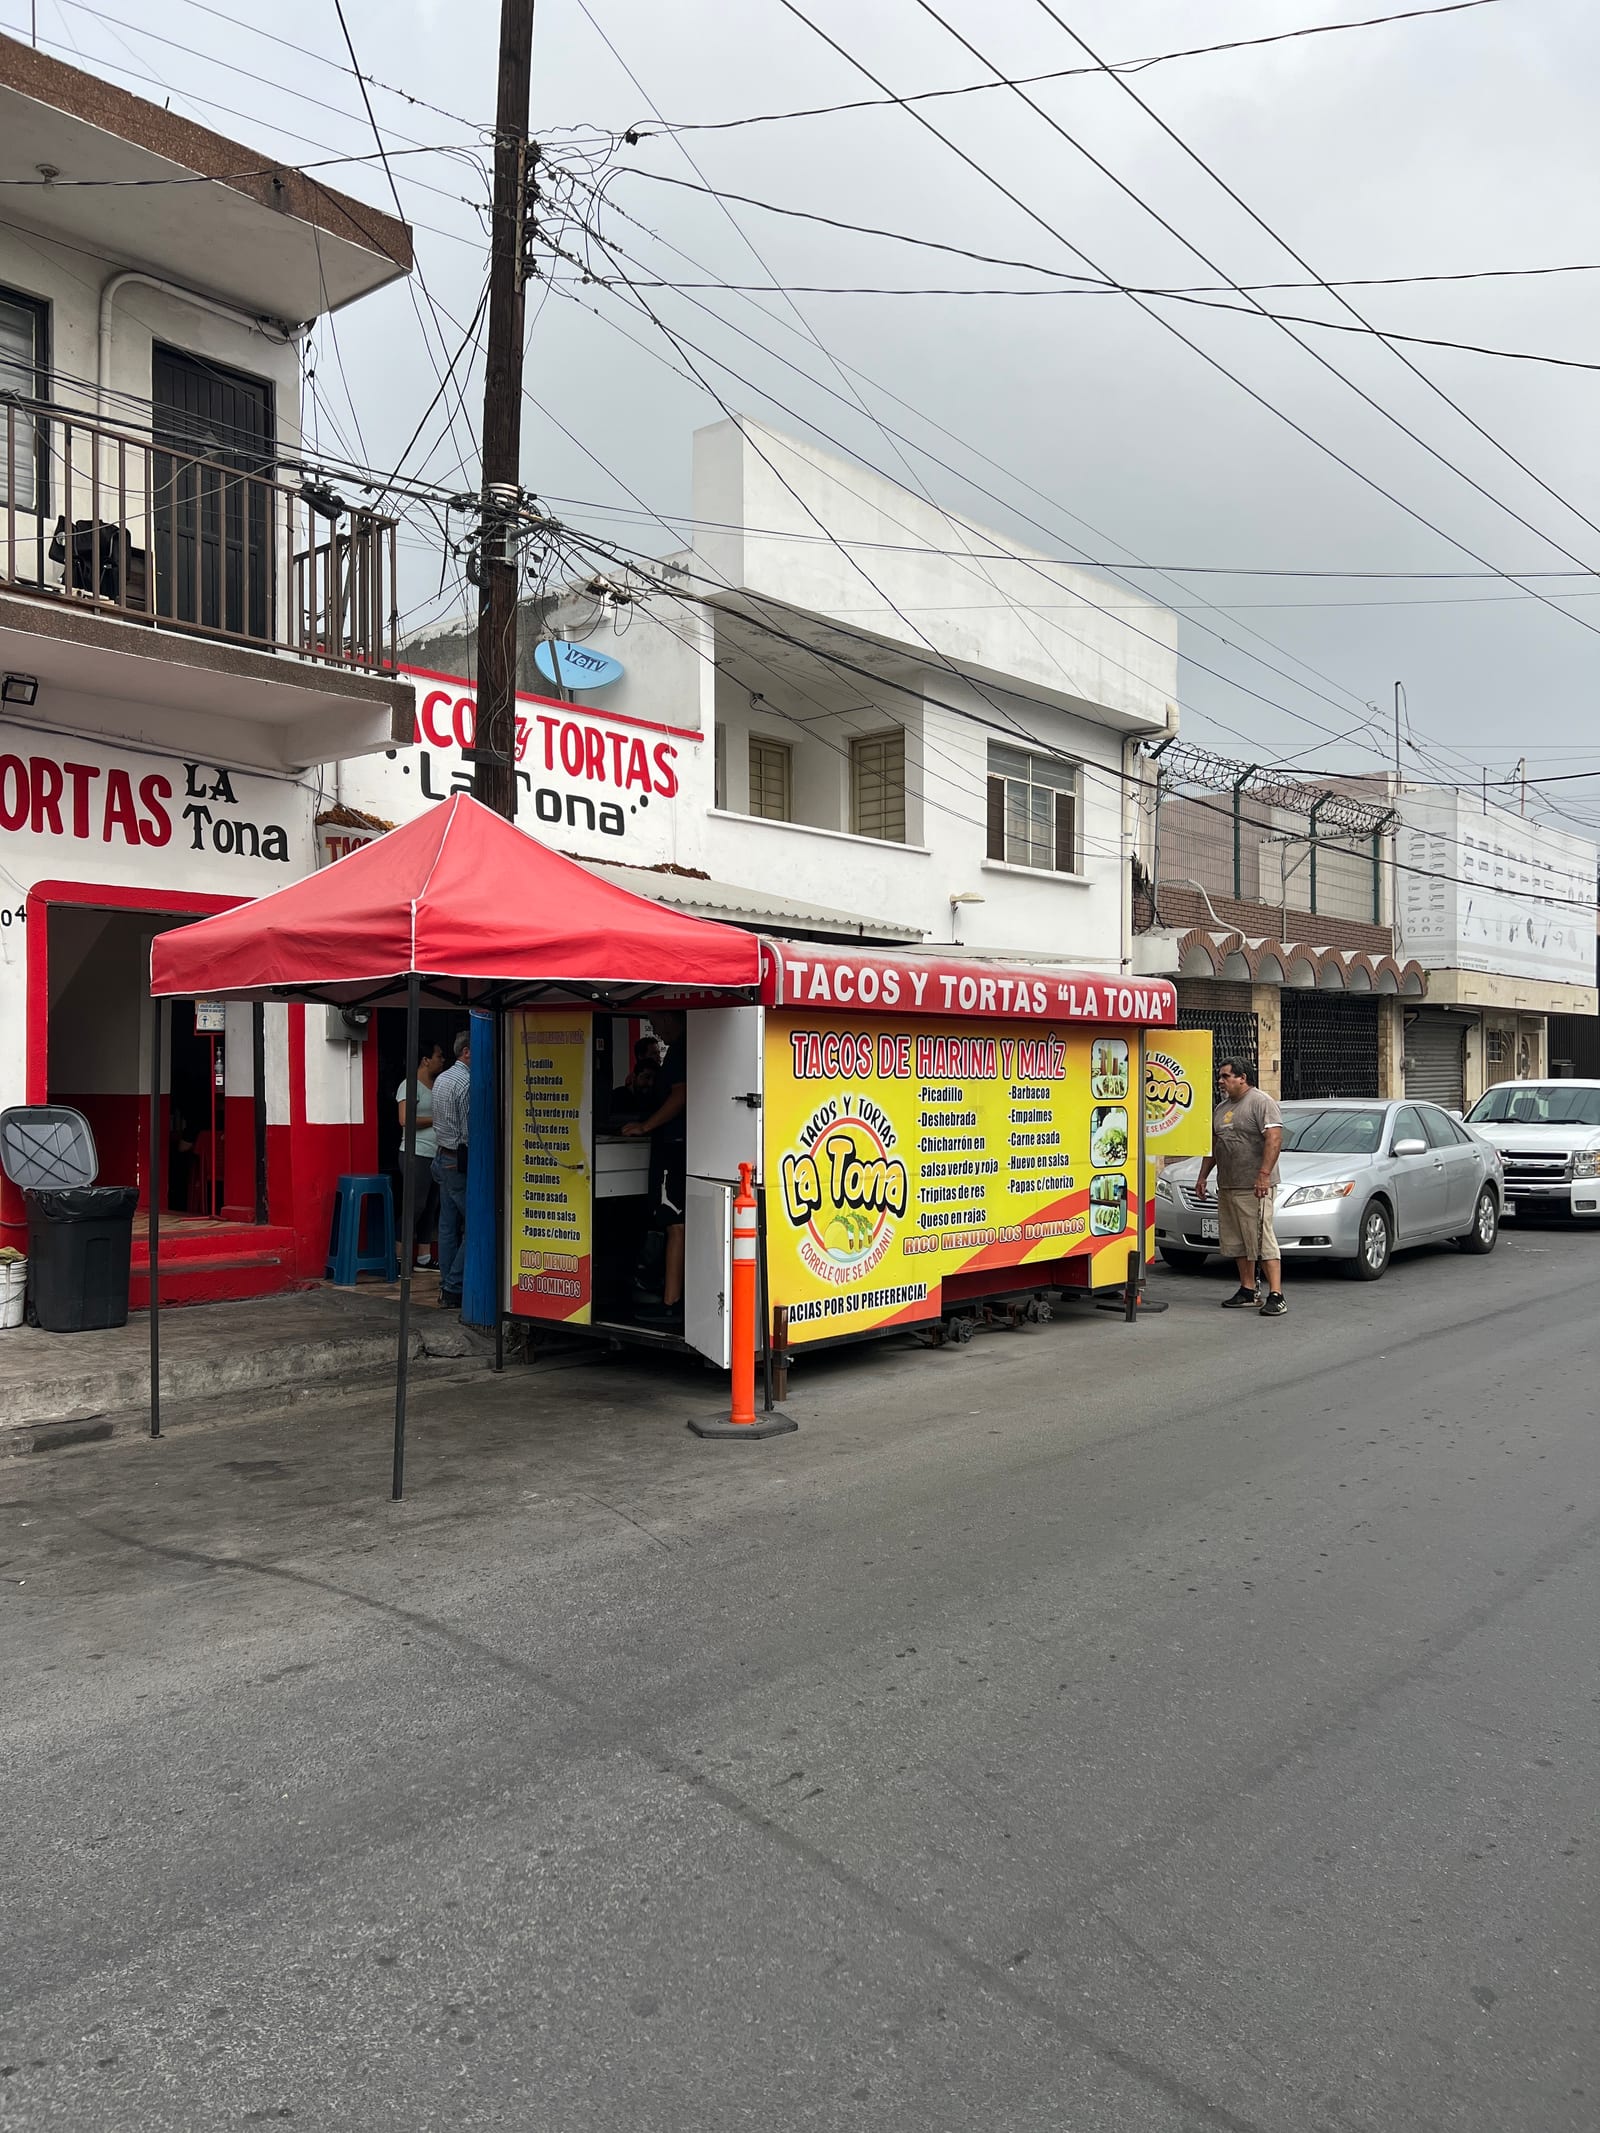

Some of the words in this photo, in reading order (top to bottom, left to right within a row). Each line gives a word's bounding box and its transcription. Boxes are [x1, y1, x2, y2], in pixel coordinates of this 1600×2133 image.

[568, 650, 608, 672] VeTV
[413, 691, 476, 748] CO
[537, 715, 678, 798] TORTAS
[183, 763, 239, 803] LA
[0, 754, 172, 847] ORTAS
[182, 803, 290, 862] Tona
[785, 960, 900, 1005] TACOS
[908, 971, 929, 1006] Y
[939, 975, 1047, 1013] TORTAS
[790, 1030, 873, 1079] TACOS
[878, 1033, 912, 1079] DE
[916, 1036, 997, 1080] HARINA
[1000, 1039, 1016, 1080] Y
[1018, 1032, 1066, 1080] MAÍZ
[1155, 1053, 1184, 1077] TORTAS
[542, 1108, 560, 1118] verde
[800, 1100, 837, 1148] TACOS
[843, 1096, 852, 1116] Y
[859, 1098, 897, 1148] TORTAS
[549, 1124, 558, 1134] de
[558, 1125, 569, 1134] res
[1036, 1130, 1060, 1144] asada
[553, 1140, 570, 1152] rajas
[973, 1138, 985, 1150] en
[920, 1162, 946, 1178] salsa
[948, 1160, 974, 1176] verde
[974, 1163, 981, 1176] y
[981, 1158, 998, 1175] roja
[1037, 1156, 1048, 1168] en
[1048, 1152, 1069, 1167] salsa
[782, 1153, 822, 1227] La
[826, 1134, 908, 1219] Tona
[958, 1184, 969, 1198] de
[970, 1186, 985, 1198] res
[1036, 1176, 1074, 1192] c/chorizo
[546, 1191, 568, 1203] asada
[546, 1211, 556, 1221] en
[556, 1210, 576, 1222] salsa
[950, 1211, 962, 1225] en
[963, 1207, 986, 1224] rajas
[546, 1227, 581, 1241] c/chorizo
[903, 1236, 938, 1255] RICO
[941, 1228, 996, 1251] MENUDO
[998, 1225, 1022, 1243] LOS
[1024, 1217, 1085, 1240] DOMINGOS
[520, 1250, 542, 1269] RICO
[543, 1251, 579, 1273] MENUDO
[800, 1242, 835, 1282] CORRELE
[834, 1267, 850, 1286] QUE
[852, 1264, 863, 1281] SE
[518, 1272, 534, 1292] LOS
[536, 1275, 582, 1299] DOMINGOS
[824, 1298, 844, 1317] POR
[846, 1294, 860, 1312] SU
[861, 1283, 928, 1310] PREFERENCIA!
